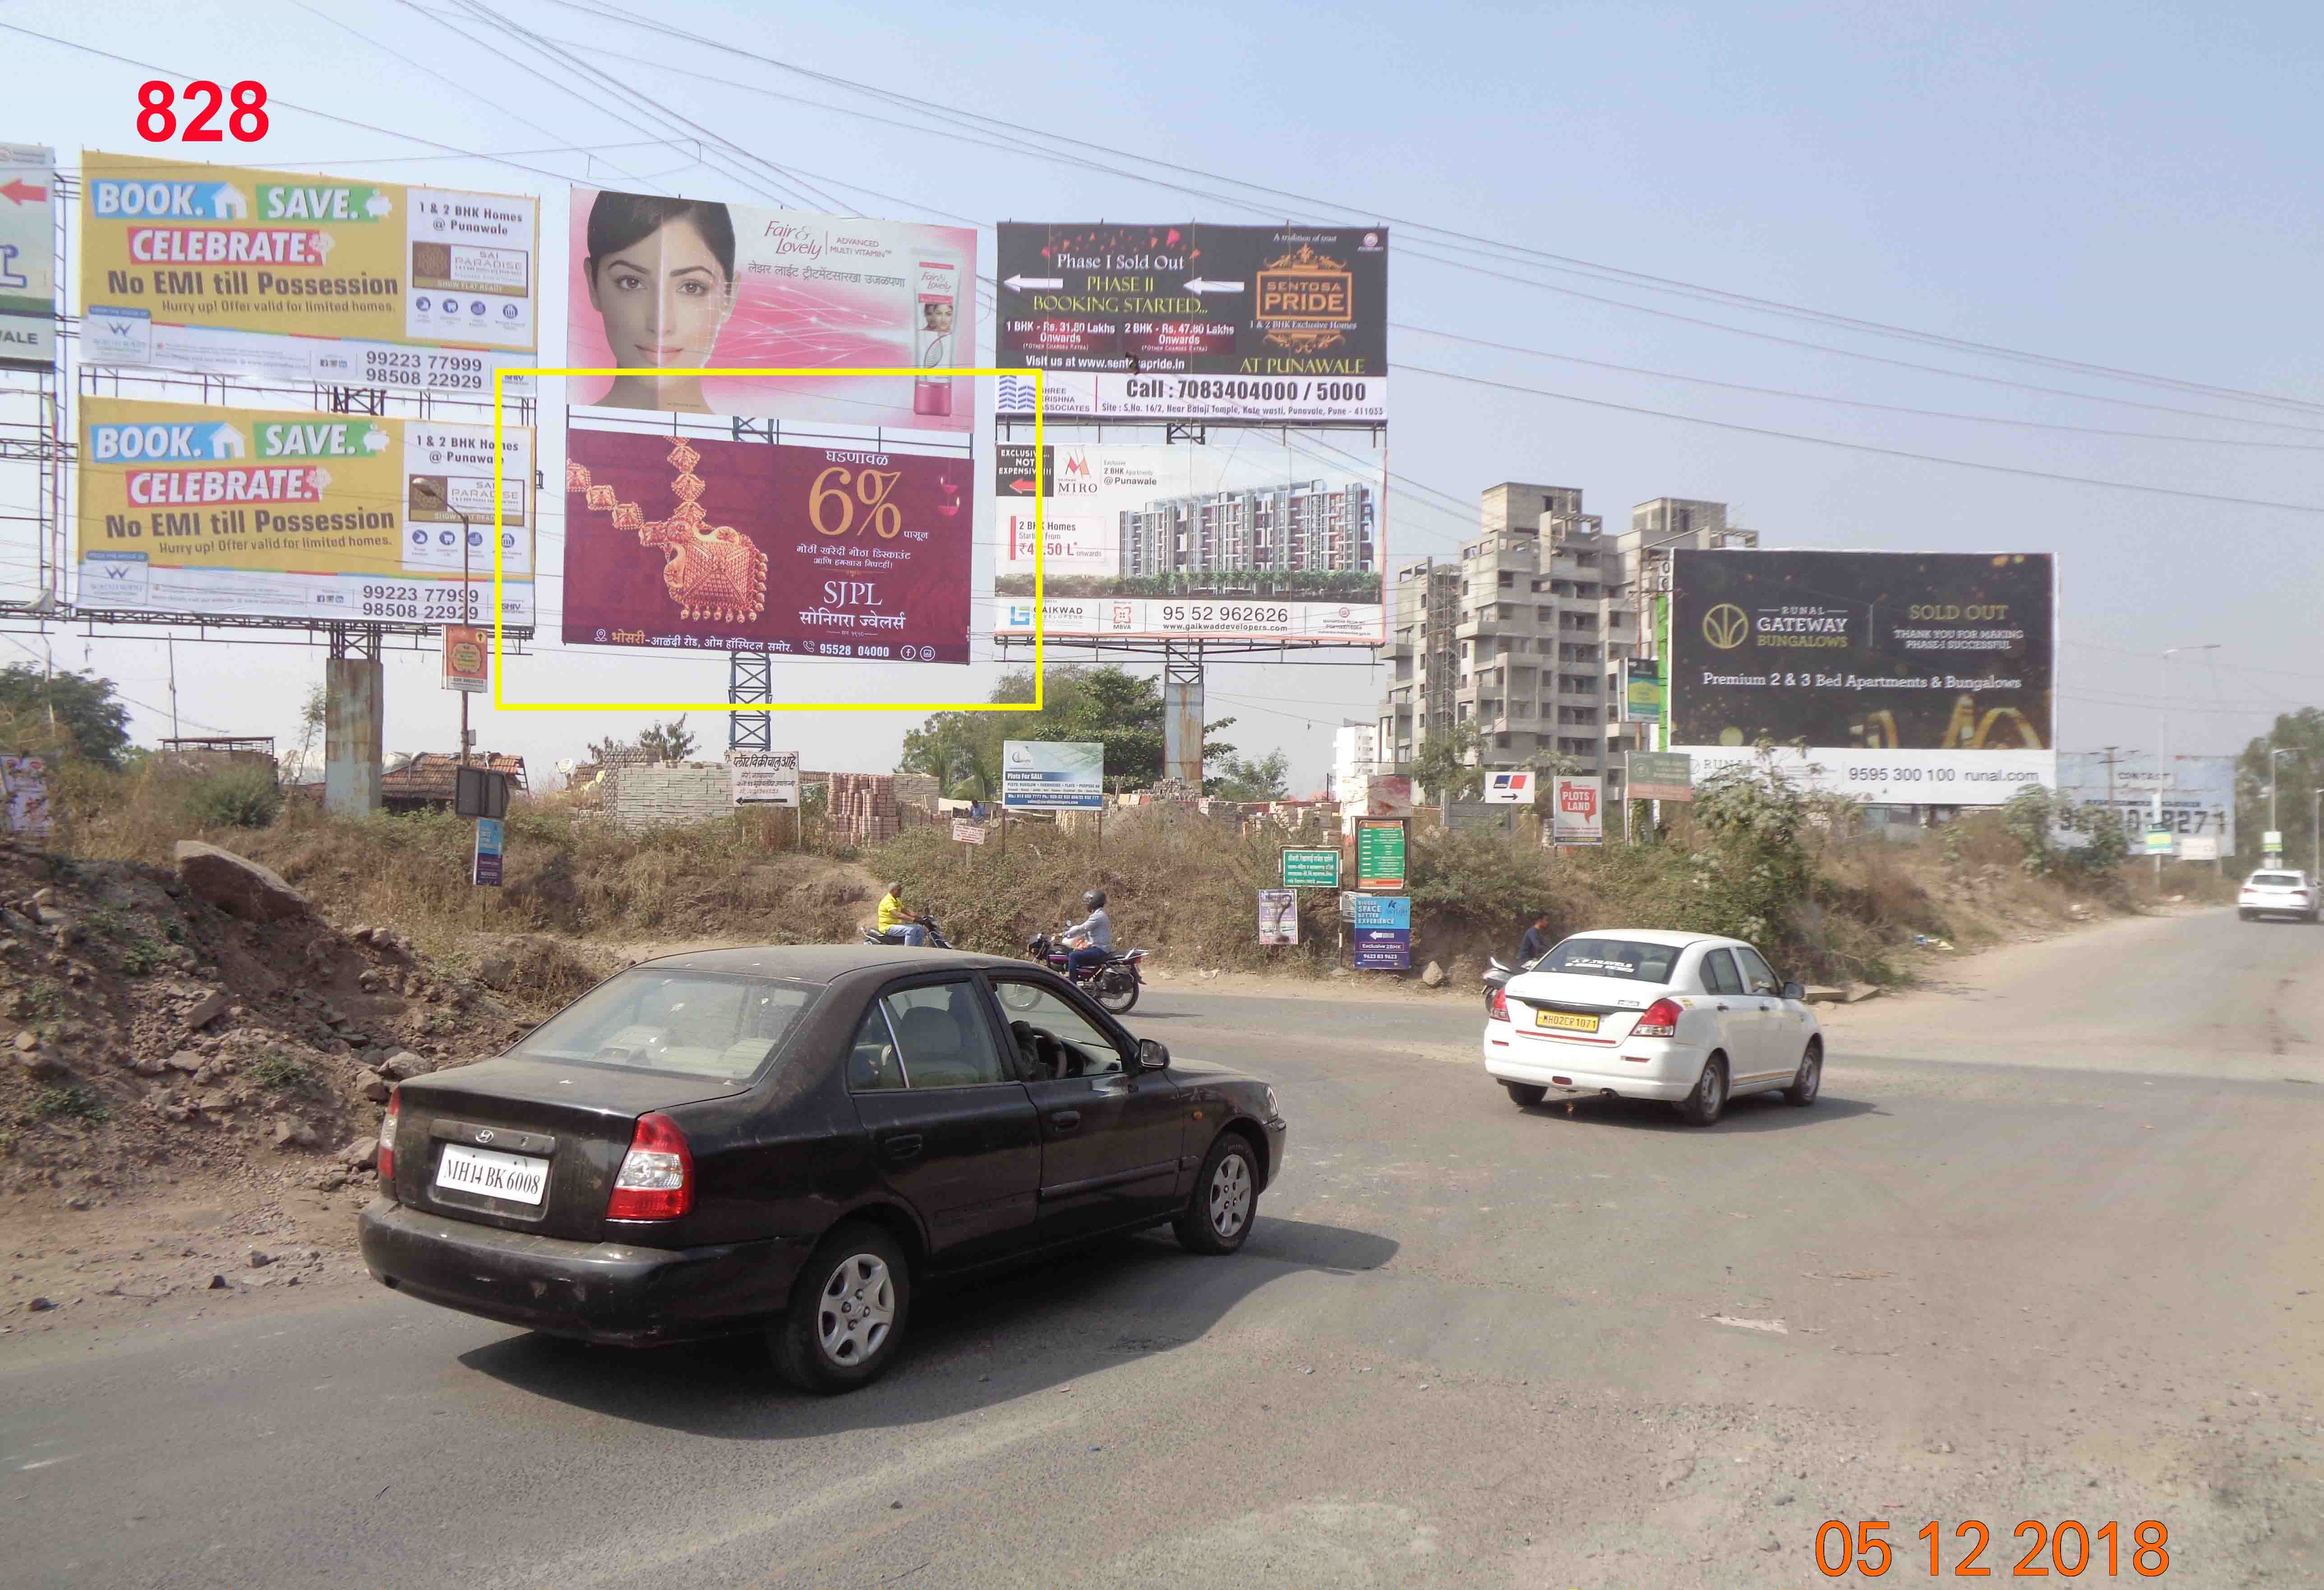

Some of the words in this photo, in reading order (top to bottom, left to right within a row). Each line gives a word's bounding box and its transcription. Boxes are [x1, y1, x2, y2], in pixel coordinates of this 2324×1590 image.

[98, 183, 205, 216] BOOK.
[267, 187, 359, 219] SAVE.
[420, 203, 424, 212] 1
[430, 203, 438, 214] &
[443, 204, 449, 215] 2
[455, 206, 479, 218] BHK
[484, 208, 522, 222] Homes
[433, 218, 445, 230] @
[451, 220, 508, 235] Punawale
[765, 221, 795, 237] Fair
[795, 225, 811, 240] &
[133, 230, 316, 263] CELEBRATE.
[775, 238, 822, 260] Lovely
[830, 245, 852, 255] MULTI
[836, 237, 879, 248] ADVANCED
[1057, 253, 1101, 269] Phase
[1116, 253, 1149, 270] Sold
[1154, 255, 1185, 271] Out
[108, 271, 143, 294] No
[154, 271, 204, 295] EMI
[213, 272, 248, 295] till
[258, 272, 398, 295] Possession
[1087, 276, 1141, 293] PHASE
[1267, 281, 1342, 291] SENTOSA
[162, 300, 194, 313] Hurry
[198, 300, 217, 313] up!
[222, 300, 249, 311] Offer
[254, 300, 282, 311] valid
[287, 300, 302, 311] for
[306, 301, 348, 312] limited
[352, 301, 395, 313] homes.
[1033, 295, 1120, 313] BOOKING
[1265, 293, 1345, 312] PRIDE
[1006, 322, 1012, 332] 1
[1014, 322, 1034, 332] BHK
[1043, 323, 1058, 332] Rs.
[1087, 323, 1116, 334] Lakhs
[1125, 323, 1130, 333] 2
[1133, 323, 1153, 333] BHK
[1162, 324, 1176, 334] Rs.
[1206, 325, 1234, 336] Lakhs
[1273, 321, 1291, 329] BHK
[1292, 321, 1329, 330] Exclusive
[1330, 322, 1358, 331] Homes
[1040, 333, 1081, 344] Onwards
[1159, 335, 1200, 346] Onwards
[366, 351, 421, 369] 99223
[428, 355, 482, 372] 77999
[1025, 355, 1047, 367] Visit
[1050, 358, 1062, 367] us
[1065, 357, 1076, 367] at
[1240, 358, 1263, 373] AT
[1267, 358, 1366, 375] PUNAWALE
[366, 369, 420, 386] 98508
[428, 372, 482, 389] 22929
[1126, 379, 1164, 398] Call
[1177, 380, 1298, 401] 7083404000
[1317, 382, 1366, 401] 5000
[97, 427, 202, 459] BOOK.
[266, 424, 357, 456] SAVE.
[826, 451, 890, 466] घडणावळ
[1015, 458, 1036, 466] NOT
[131, 469, 313, 504] CELEBRATE.
[1058, 483, 1097, 493] MIRO
[1104, 477, 1113, 486] @
[1115, 477, 1157, 486] Punawale
[809, 466, 901, 539] 6%
[904, 531, 928, 542] पासून
[797, 544, 817, 554] मोठी
[820, 545, 845, 556] खरेदी
[849, 547, 869, 558] मोठा
[873, 547, 911, 560] डिस्काउंट
[813, 556, 832, 566] आणि
[823, 580, 883, 609] SJPL
[799, 607, 856, 628] सोनिगरा
[859, 609, 906, 630] ज्वेलर्स
[1163, 606, 1185, 621] 95
[1191, 607, 1213, 621] 52
[1220, 607, 1288, 622] 962626
[1909, 604, 1960, 620] SOLD
[1965, 604, 2009, 620] OUT
[1163, 623, 1288, 632] www.gaikwaddevelopers.com
[1757, 618, 1848, 632] GATEWAY
[1757, 635, 1848, 648] BUNGALOWS
[1894, 629, 1932, 639] THANK
[1933, 629, 1955, 639] YOU
[1956, 629, 1979, 639] FOR
[1980, 630, 2024, 639] MAKING
[684, 635, 701, 648] रोड,
[704, 635, 723, 648] ओम
[725, 636, 764, 651] हॉस्पिटल
[767, 638, 793, 653] समोर.
[820, 643, 852, 656] 95528
[858, 645, 890, 658] 04000
[1947, 640, 2013, 650] SUCCESSFUL
[1703, 672, 1766, 686] Premium
[1770, 673, 1781, 686] 2
[1784, 673, 1796, 686] &
[1800, 673, 1812, 687] 3
[1815, 673, 1842, 687] Bed
[1844, 674, 1928, 690] Apartments
[1930, 677, 1942, 688] &
[1944, 675, 2022, 692] Bungalows
[1849, 767, 1888, 781] 9595
[1892, 768, 1922, 782] 300
[1927, 768, 1956, 782] 100
[1964, 769, 2040, 782] runal.com
[1563, 791, 1590, 801] PLOTS
[1567, 802, 1590, 811] LAND
[444, 1159, 484, 1184] MH14
[485, 1166, 505, 1188] BK
[507, 1170, 541, 1194] 6008
